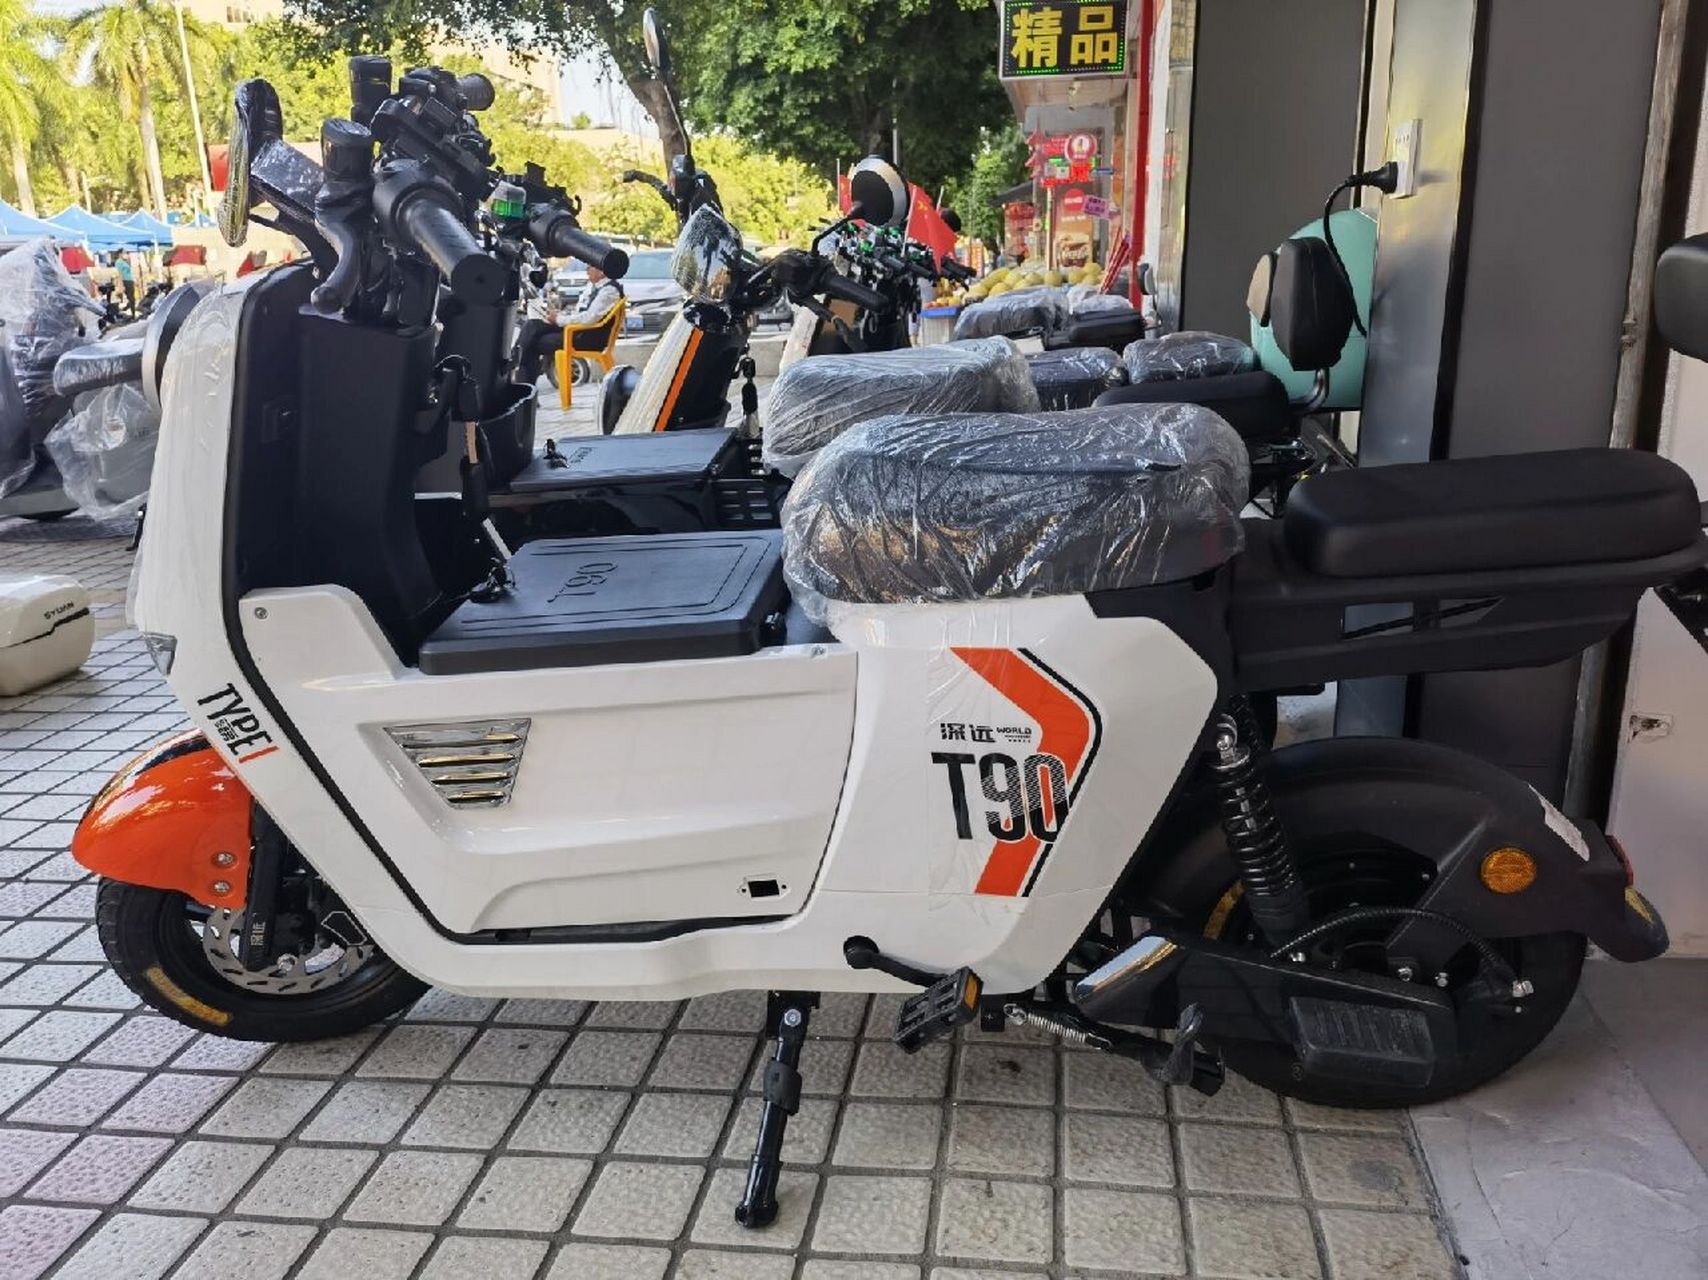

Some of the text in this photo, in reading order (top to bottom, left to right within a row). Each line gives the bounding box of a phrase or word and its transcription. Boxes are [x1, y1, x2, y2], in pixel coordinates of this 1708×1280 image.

[1010, 6, 1118, 68] 精品
[940, 723, 1032, 743] 深远 WORLD
[931, 751, 1069, 842] T90
